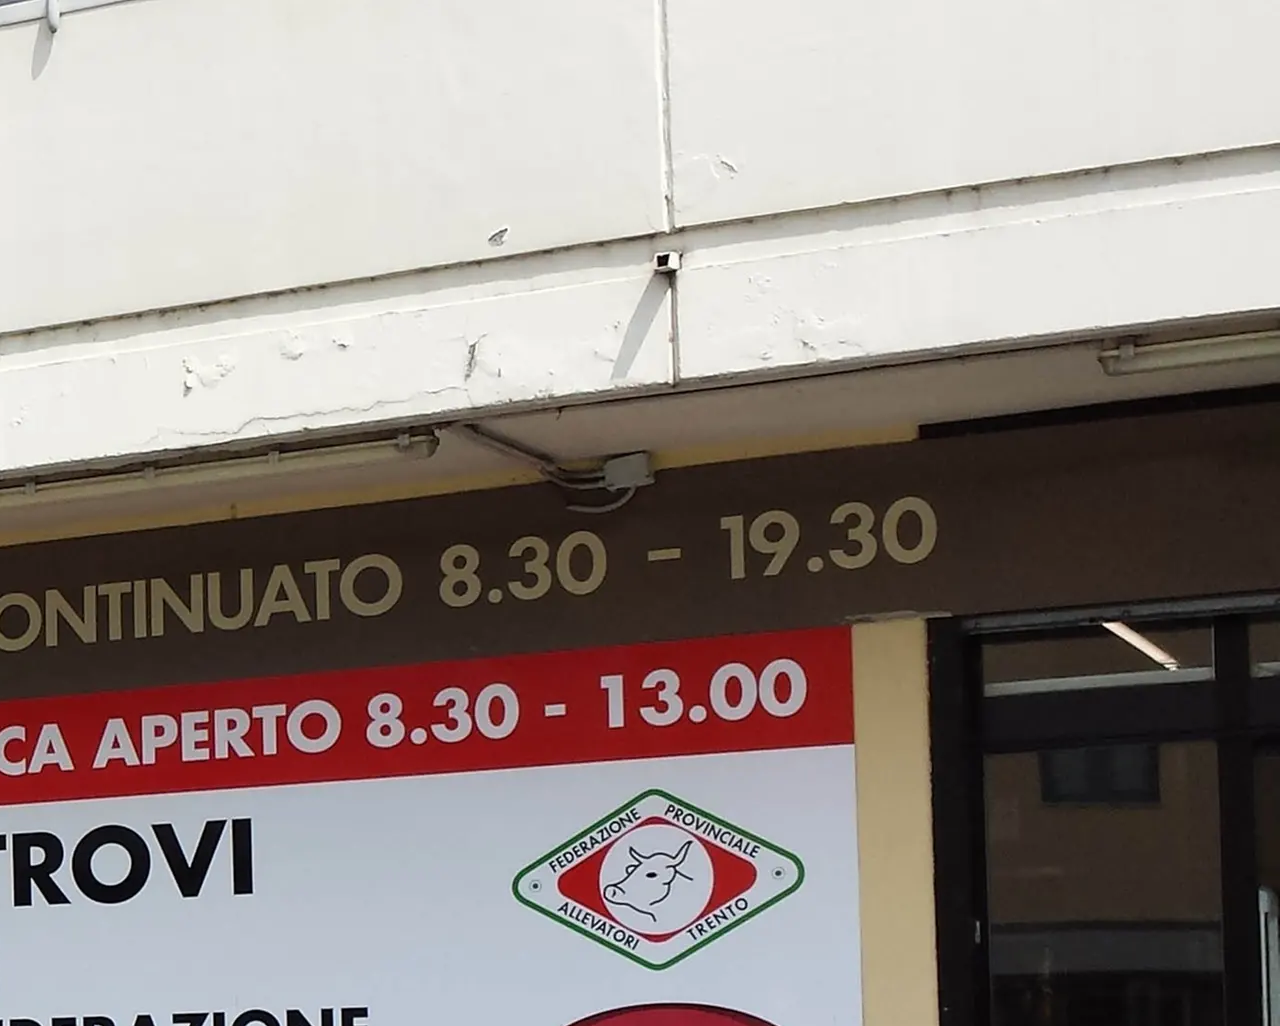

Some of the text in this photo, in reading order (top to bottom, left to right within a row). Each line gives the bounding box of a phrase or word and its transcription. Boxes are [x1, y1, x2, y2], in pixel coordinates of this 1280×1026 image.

[439, 530, 607, 608] 8.30
[720, 497, 938, 580] 19.30
[92, 699, 342, 770] APERTO
[366, 683, 520, 749] 8.30
[600, 658, 808, 729] 13.00
[548, 807, 642, 874] FEDERAZIONE
[664, 804, 761, 858] PROVINCIALE
[557, 901, 640, 951] ALLEVATORI
[686, 897, 749, 941] TRENTO
